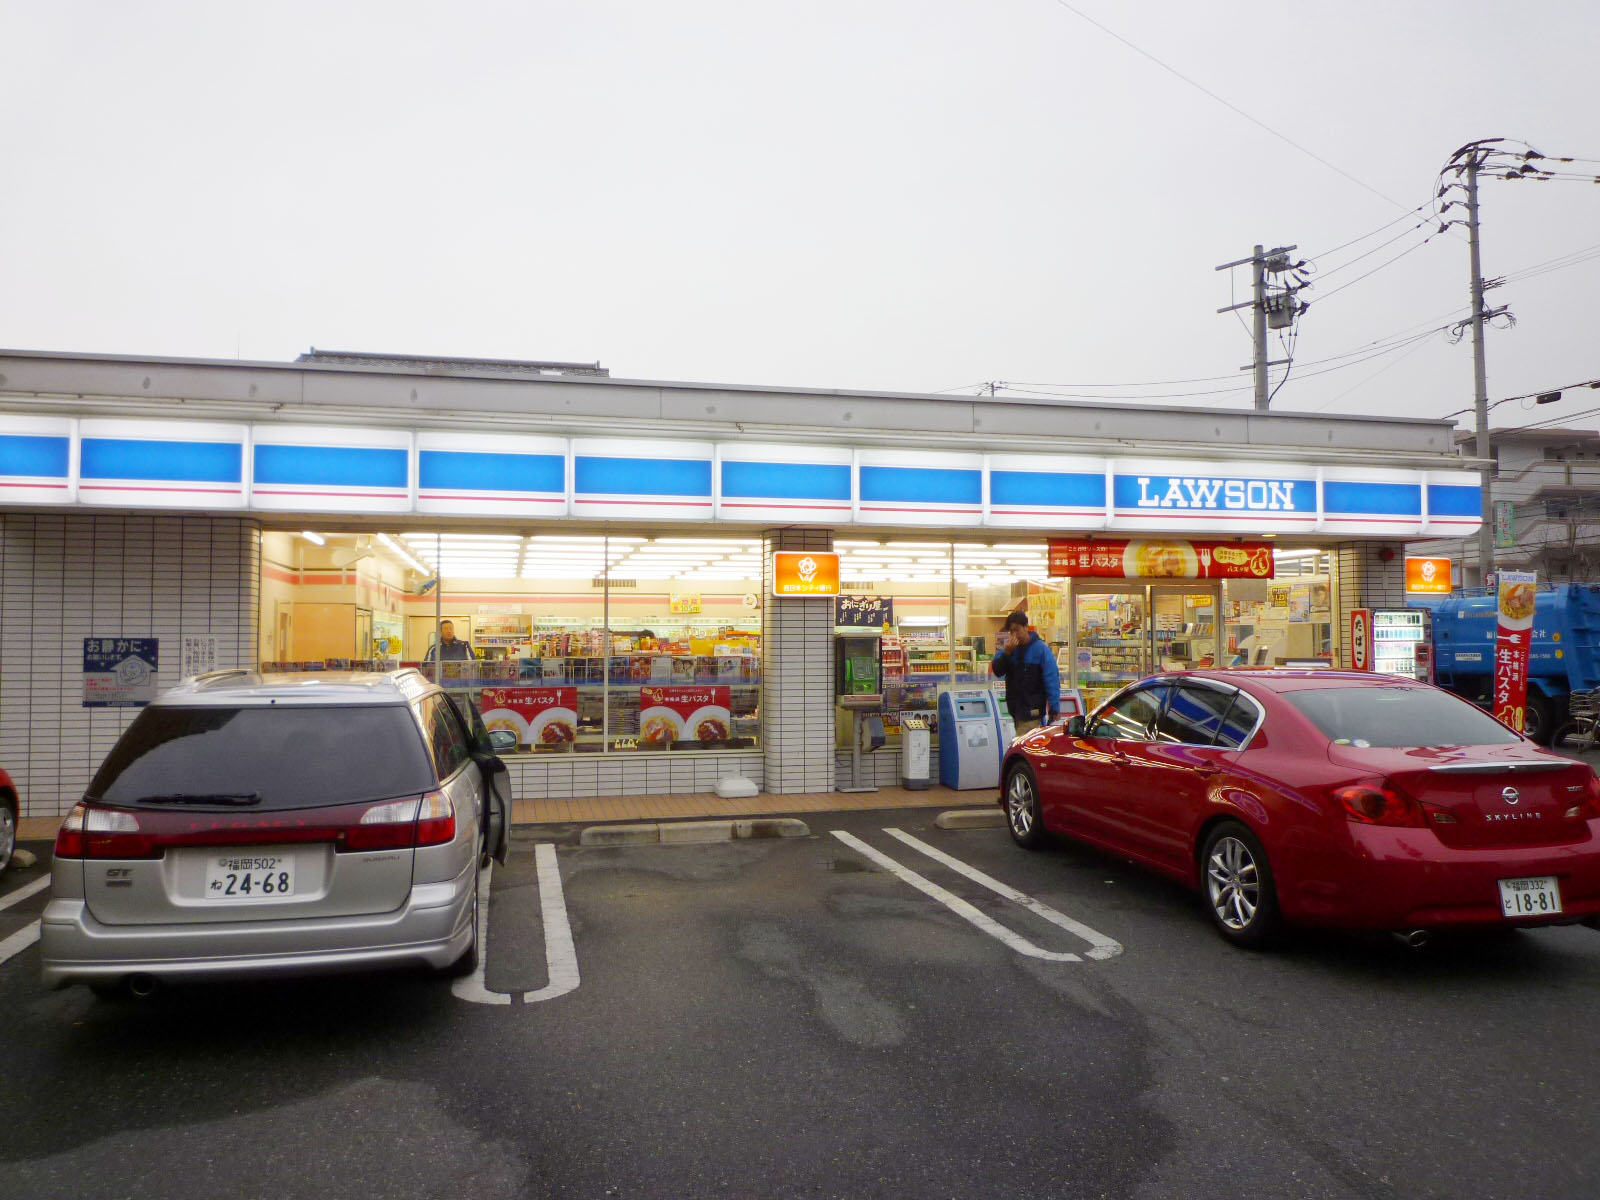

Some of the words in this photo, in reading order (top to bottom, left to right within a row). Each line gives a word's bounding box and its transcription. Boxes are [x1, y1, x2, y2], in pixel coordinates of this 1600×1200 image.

[1138, 478, 1294, 510] LAWSON
[1079, 554, 1118, 568] 生パスタ
[88, 640, 141, 652] お静かに
[1355, 620, 1364, 662] たばこ
[1498, 649, 1512, 703] 生パスタ
[525, 696, 555, 705] 生パスタ
[681, 694, 709, 703] 生パスタ
[1486, 812, 1541, 821] SKYLINE
[228, 858, 276, 870] 福岡502
[106, 868, 133, 877] GT
[210, 880, 222, 890] ね
[225, 872, 289, 895] 24-68
[1505, 899, 1512, 909] と
[1515, 891, 1556, 912] 18-81
